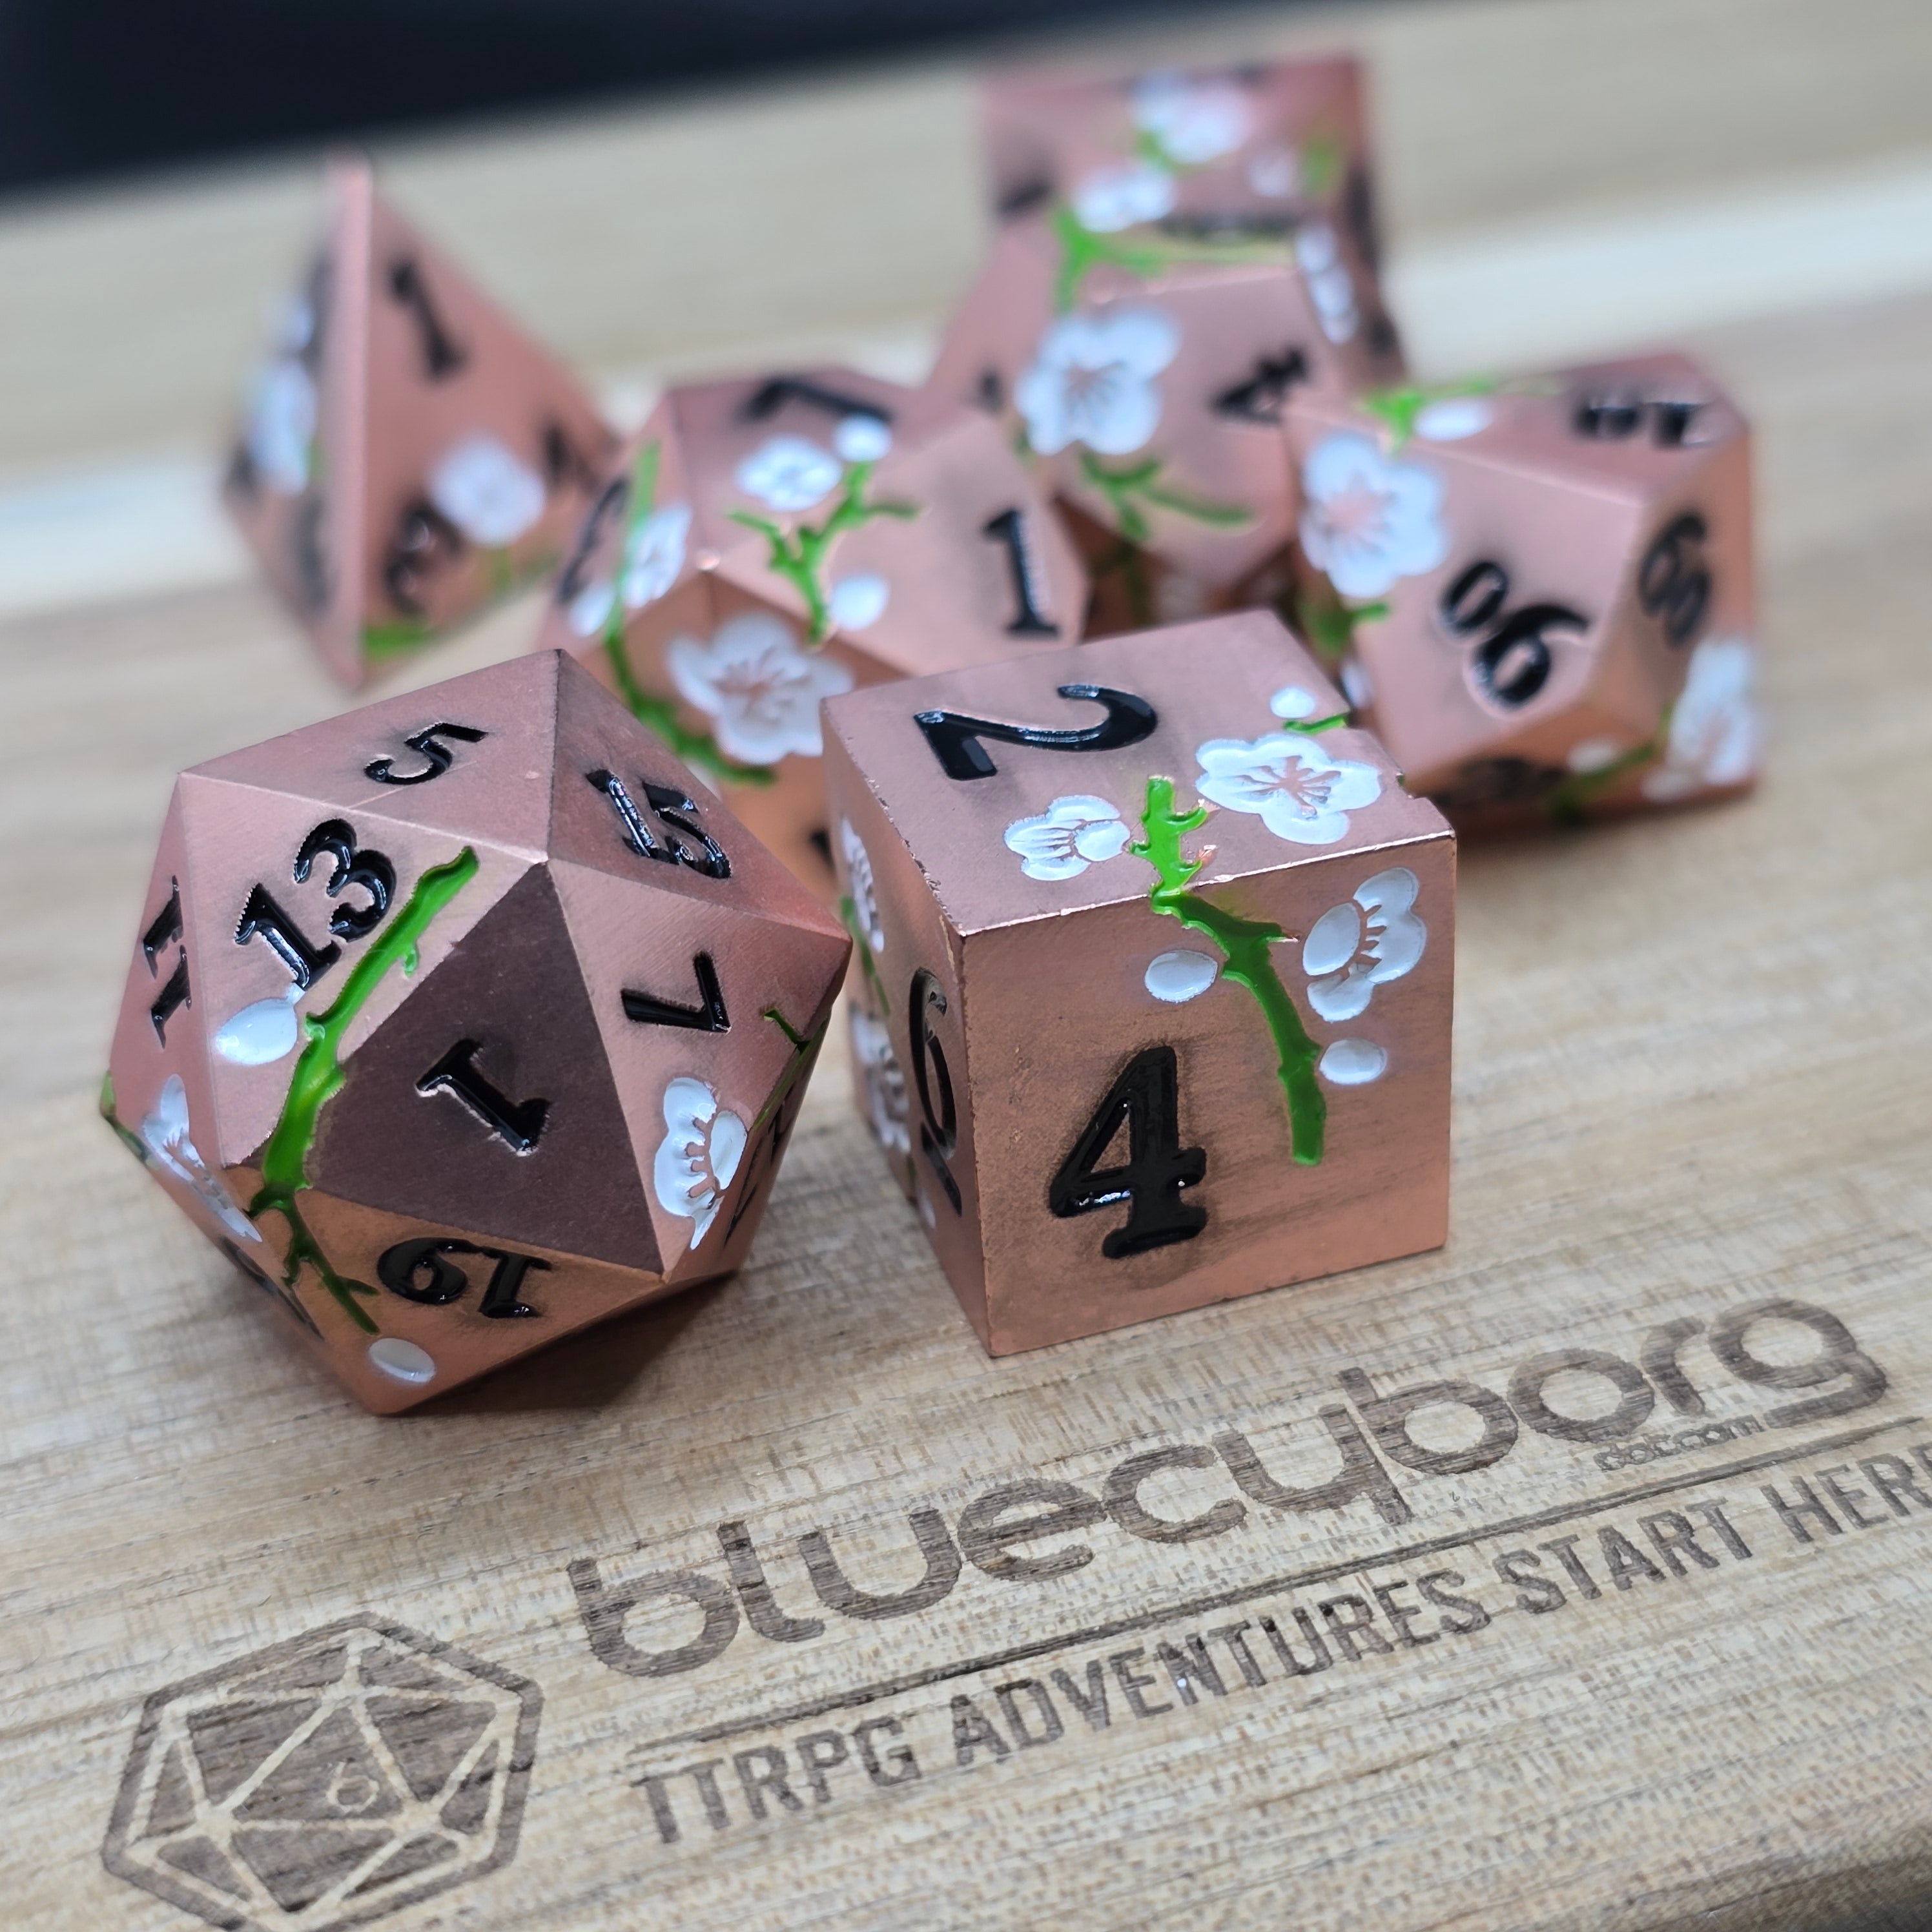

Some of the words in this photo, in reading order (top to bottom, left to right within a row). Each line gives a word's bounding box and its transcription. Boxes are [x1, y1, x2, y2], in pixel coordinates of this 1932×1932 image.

[984, 506, 1062, 641] 1
[363, 721, 489, 786] 5
[912, 683, 1158, 781] 2
[582, 768, 733, 879] 15
[234, 817, 398, 992] 13
[621, 951, 732, 1034] 7
[413, 1037, 551, 1158] 1
[1048, 1045, 1209, 1260] 4
[566, 1297, 1888, 1678] bluecyborg
[630, 1714, 923, 1845] TTRPG
[949, 1567, 1494, 1766] ADVENTURES
[1492, 1497, 1754, 1615] START
